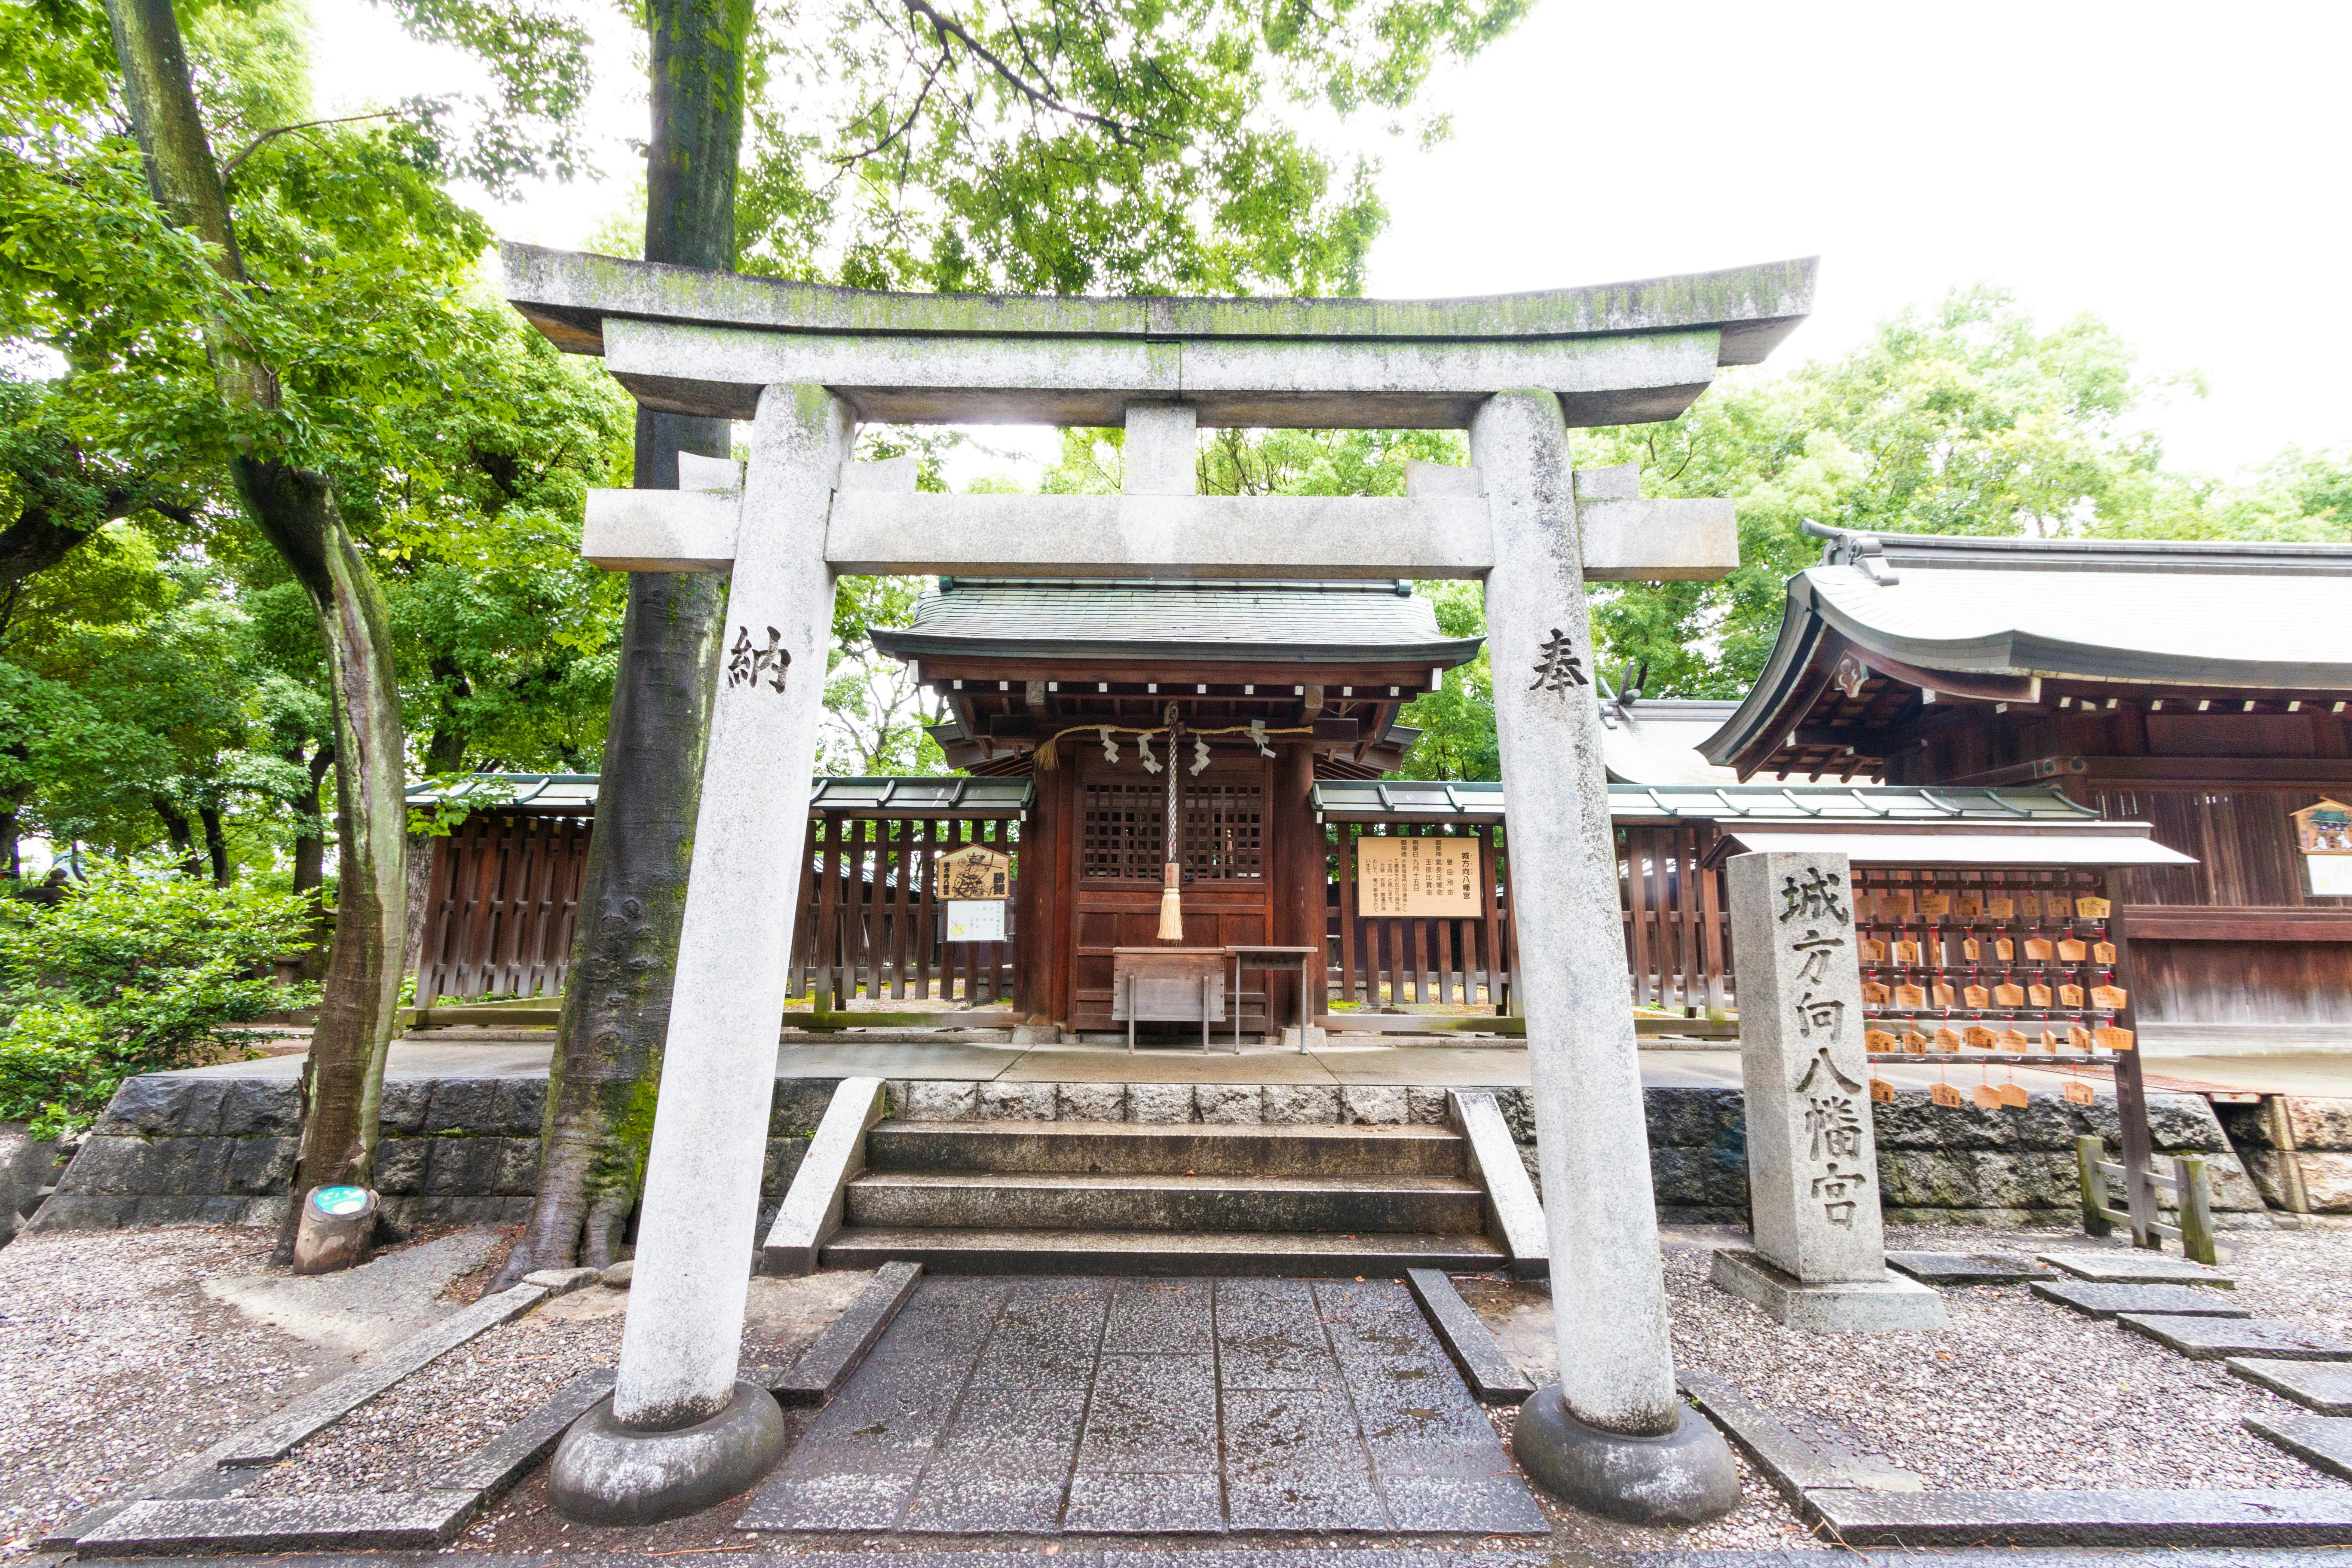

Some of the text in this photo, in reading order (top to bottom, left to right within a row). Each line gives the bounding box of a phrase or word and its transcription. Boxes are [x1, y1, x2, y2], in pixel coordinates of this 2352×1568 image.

[728, 626, 792, 694] 納
[1529, 628, 1589, 704] 奉
[1461, 852, 1470, 899] 城方向八幡宮
[1779, 867, 1867, 1231] 城方向八幡宮
